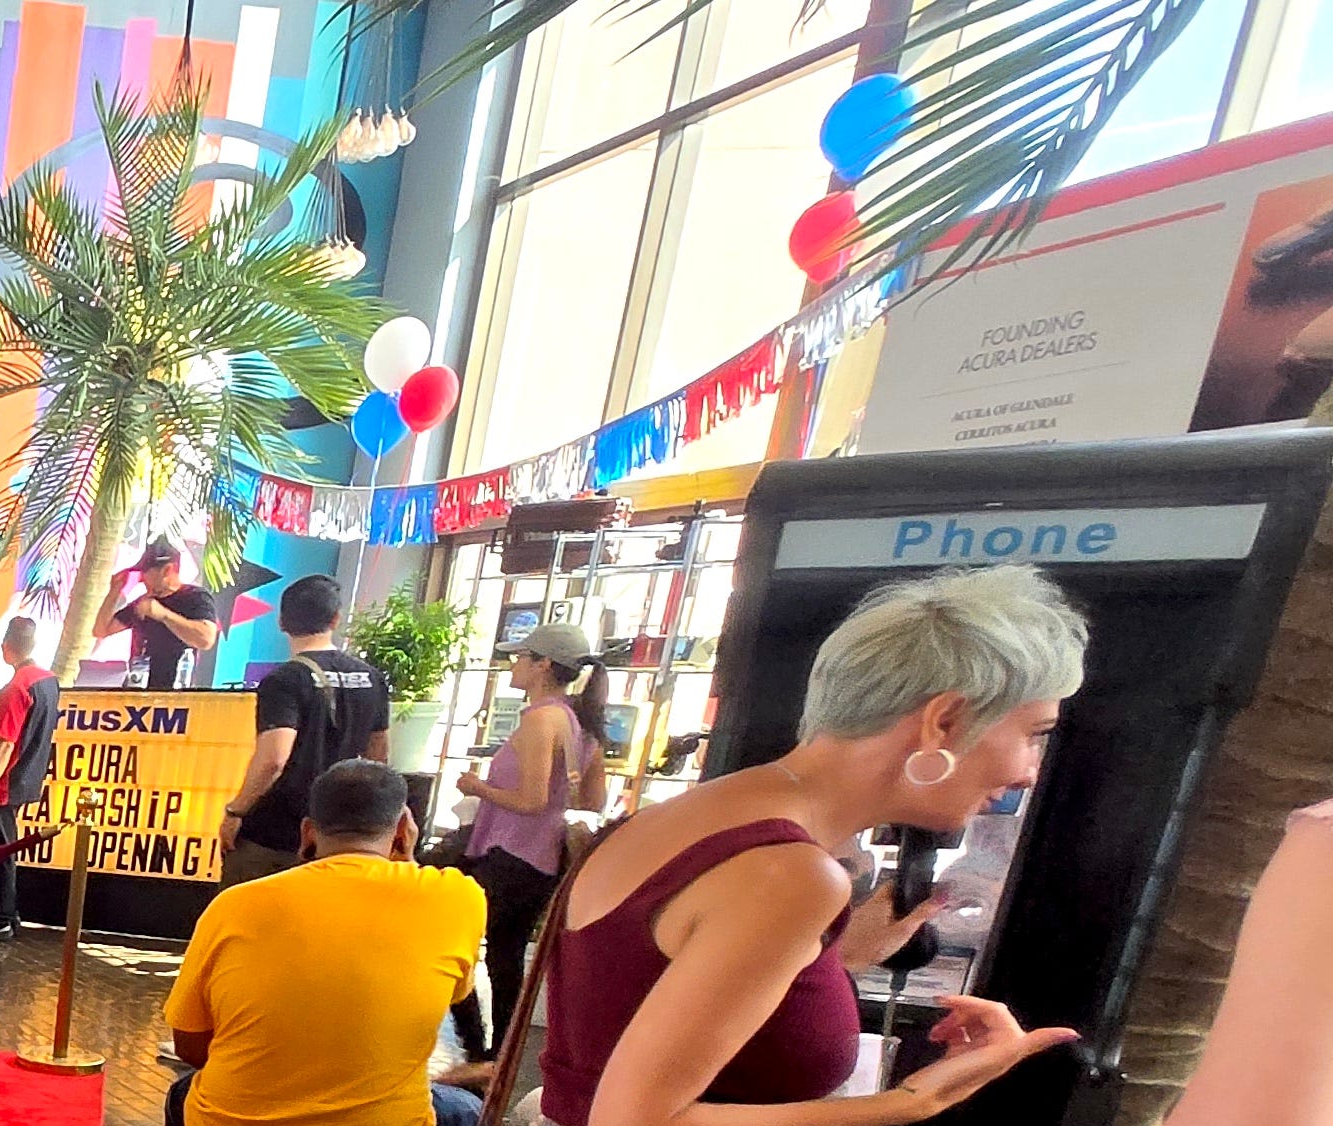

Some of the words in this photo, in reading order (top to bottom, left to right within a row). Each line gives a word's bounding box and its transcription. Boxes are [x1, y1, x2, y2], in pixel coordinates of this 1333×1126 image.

[980, 311, 1086, 347] FOUNDING
[957, 349, 1016, 374] ACURA
[1019, 331, 1099, 364] DEALERS
[892, 517, 1118, 559] Phone
[55, 704, 190, 735] riusXM
